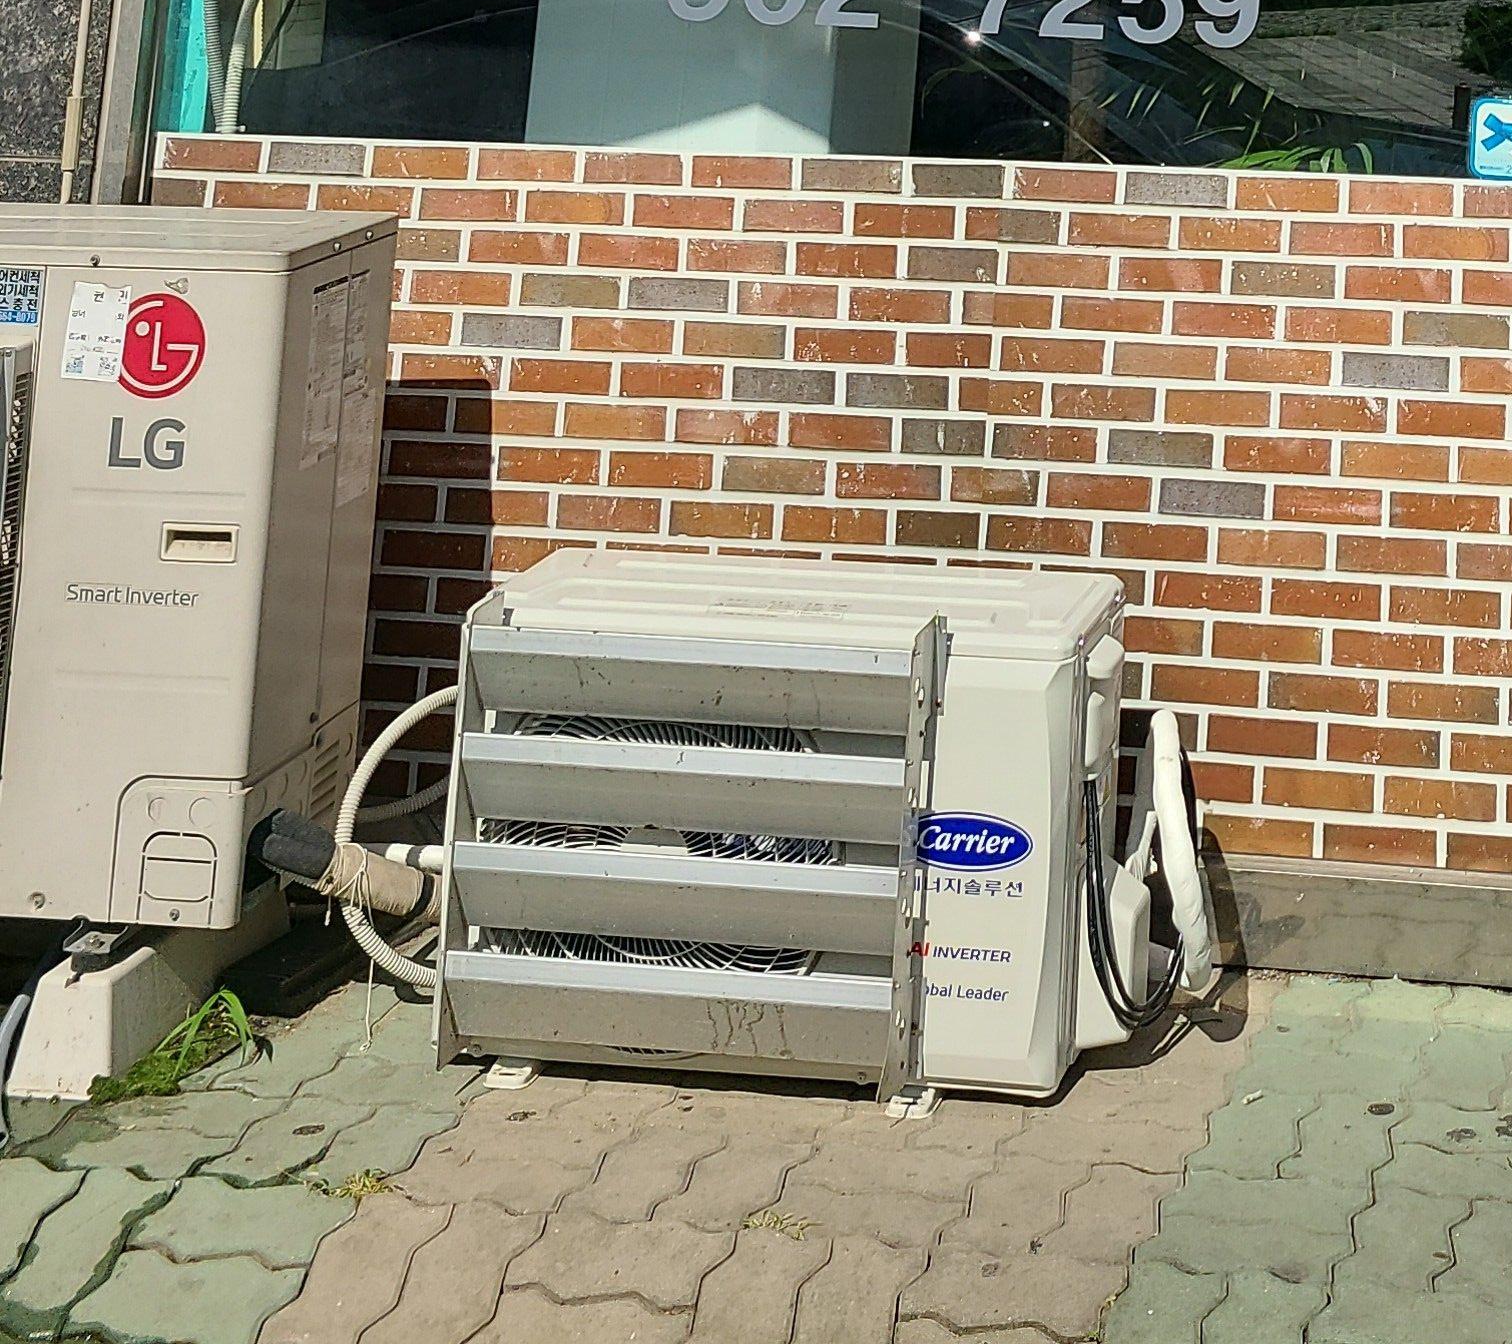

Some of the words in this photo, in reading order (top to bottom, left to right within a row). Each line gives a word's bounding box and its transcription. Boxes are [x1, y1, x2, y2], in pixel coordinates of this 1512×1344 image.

[108, 416, 186, 470] LG
[66, 583, 122, 604] Smart
[125, 586, 199, 607] Inverter
[915, 826, 1015, 854] Carrier
[932, 947, 1012, 963] INVERTER
[925, 983, 953, 998] bal
[956, 985, 1010, 1002] Leader
